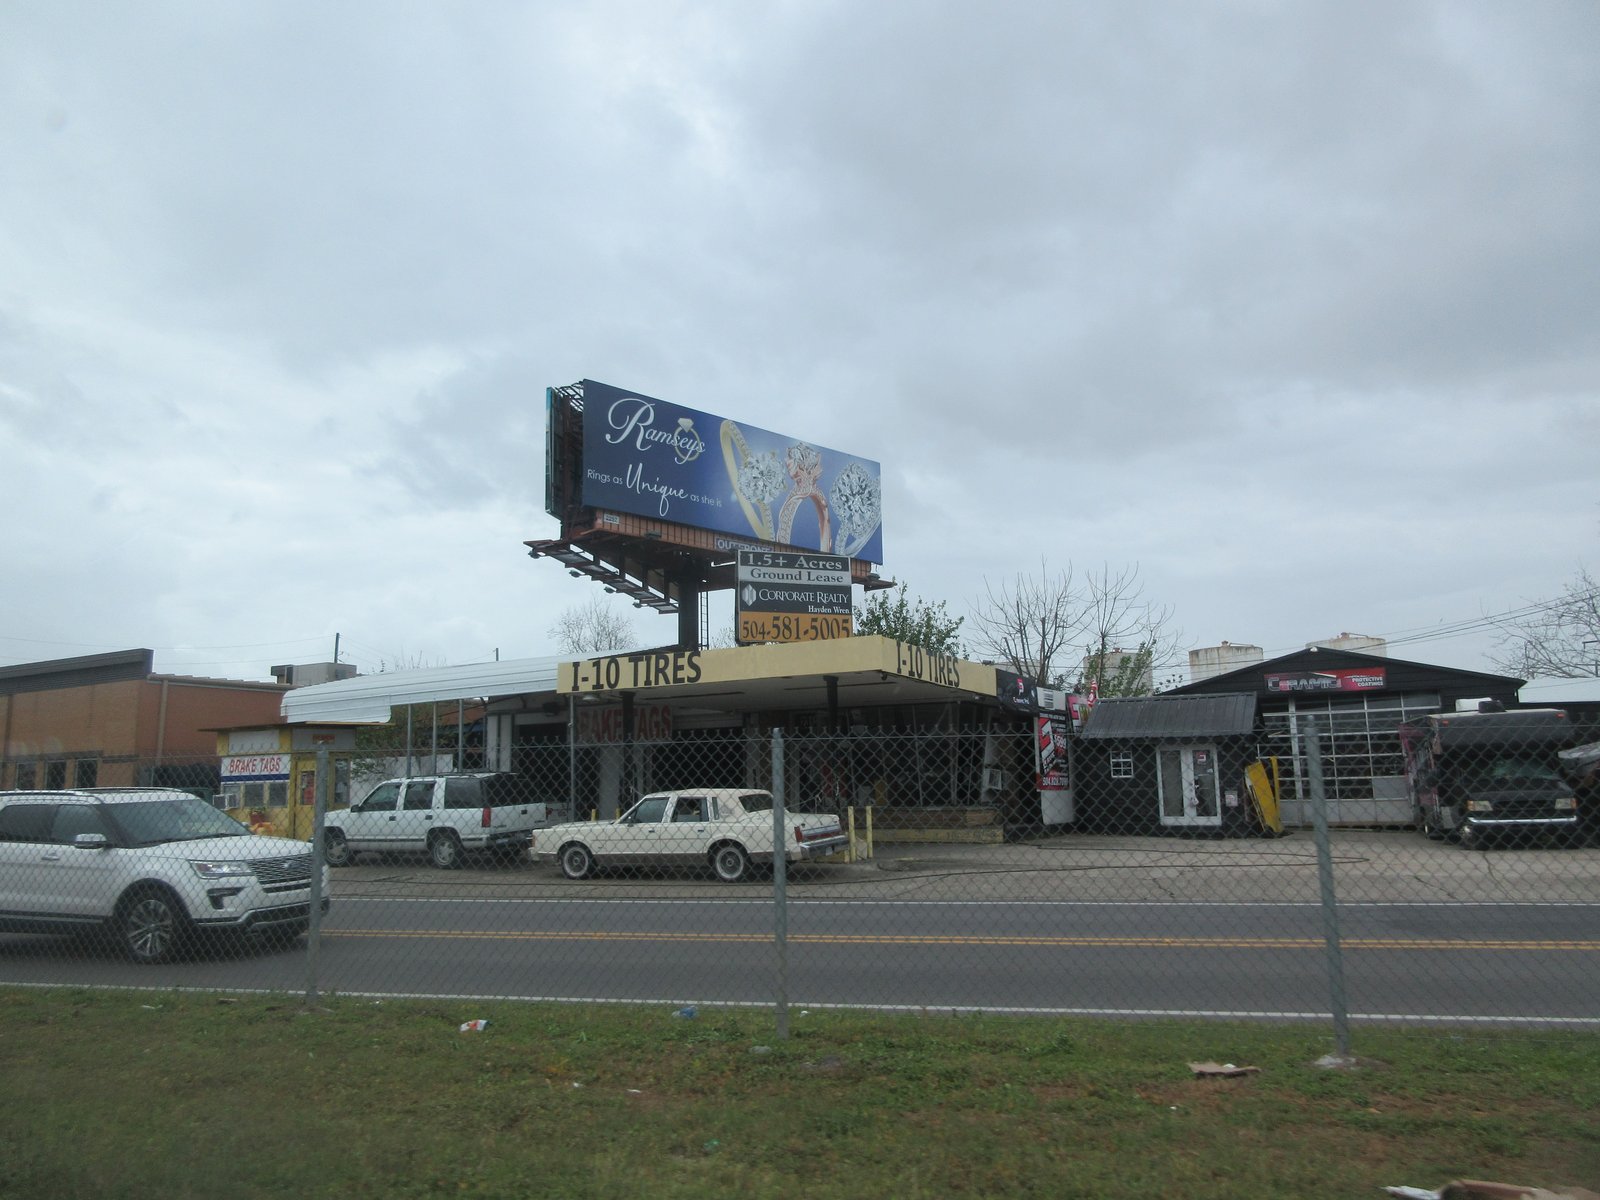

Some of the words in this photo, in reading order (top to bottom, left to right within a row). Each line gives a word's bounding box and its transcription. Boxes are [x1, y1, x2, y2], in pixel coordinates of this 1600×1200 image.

[605, 398, 705, 464] Ramseys
[587, 469, 610, 484] Rings
[613, 476, 623, 485] as
[626, 463, 688, 517] Unique
[701, 496, 714, 506] she
[716, 498, 722, 507] is
[748, 554, 787, 567] 1.5+
[795, 558, 842, 570] Acres
[750, 568, 802, 581] Ground
[807, 571, 844, 583] Lease
[759, 589, 814, 602] CORPORATE
[817, 592, 849, 604] REALTY
[808, 605, 831, 614] Hayden
[743, 616, 850, 640] 504-581-5005
[572, 657, 620, 691] I-10
[628, 651, 702, 687] TIRES
[896, 640, 923, 679] I-10
[926, 649, 960, 688] TIRES
[633, 703, 672, 740] AGS
[229, 758, 257, 773] BRAKE
[260, 757, 281, 772] TAGS
